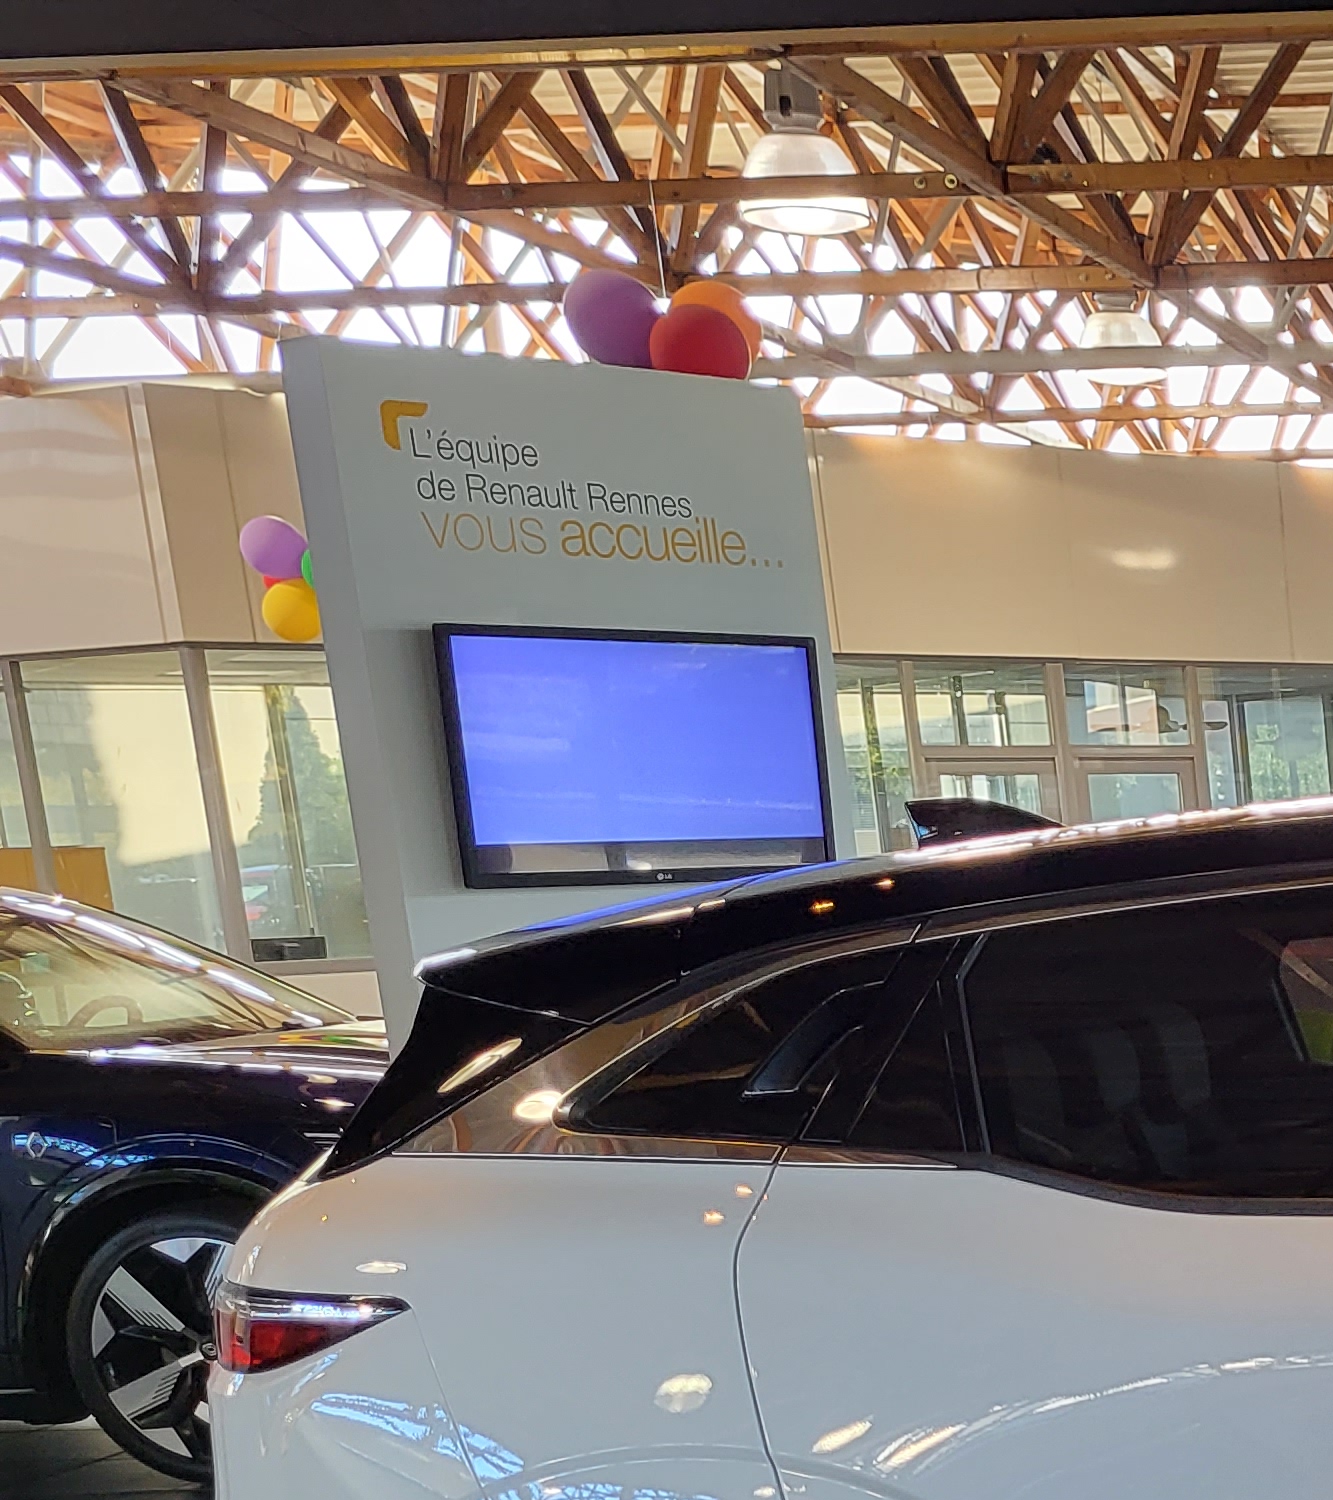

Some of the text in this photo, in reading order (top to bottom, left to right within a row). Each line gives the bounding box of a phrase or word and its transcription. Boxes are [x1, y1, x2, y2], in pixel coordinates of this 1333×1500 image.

[408, 426, 540, 473] L'équipe
[416, 470, 693, 519] de Renault Rennes
[420, 511, 784, 568] vous accueille...
